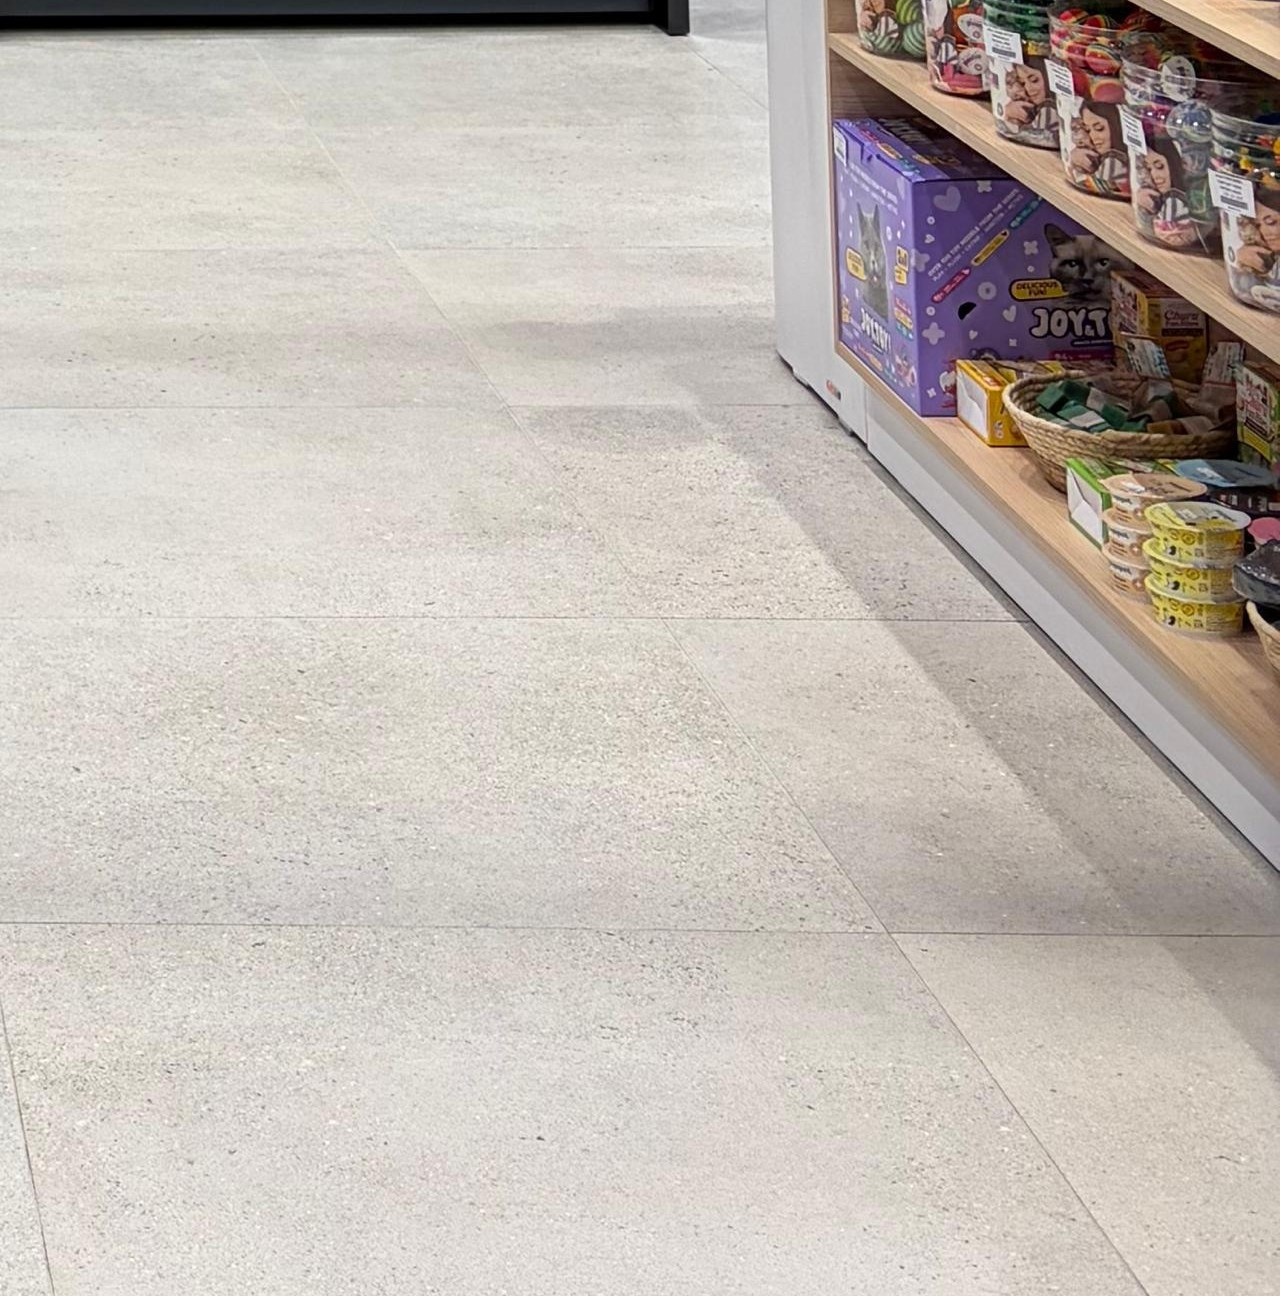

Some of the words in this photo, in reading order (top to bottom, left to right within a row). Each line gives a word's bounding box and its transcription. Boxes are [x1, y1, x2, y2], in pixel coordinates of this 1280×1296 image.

[1016, 281, 1059, 291] DELICIOUS
[1028, 289, 1047, 297] FUN!
[1031, 307, 1110, 339] JOY&T
